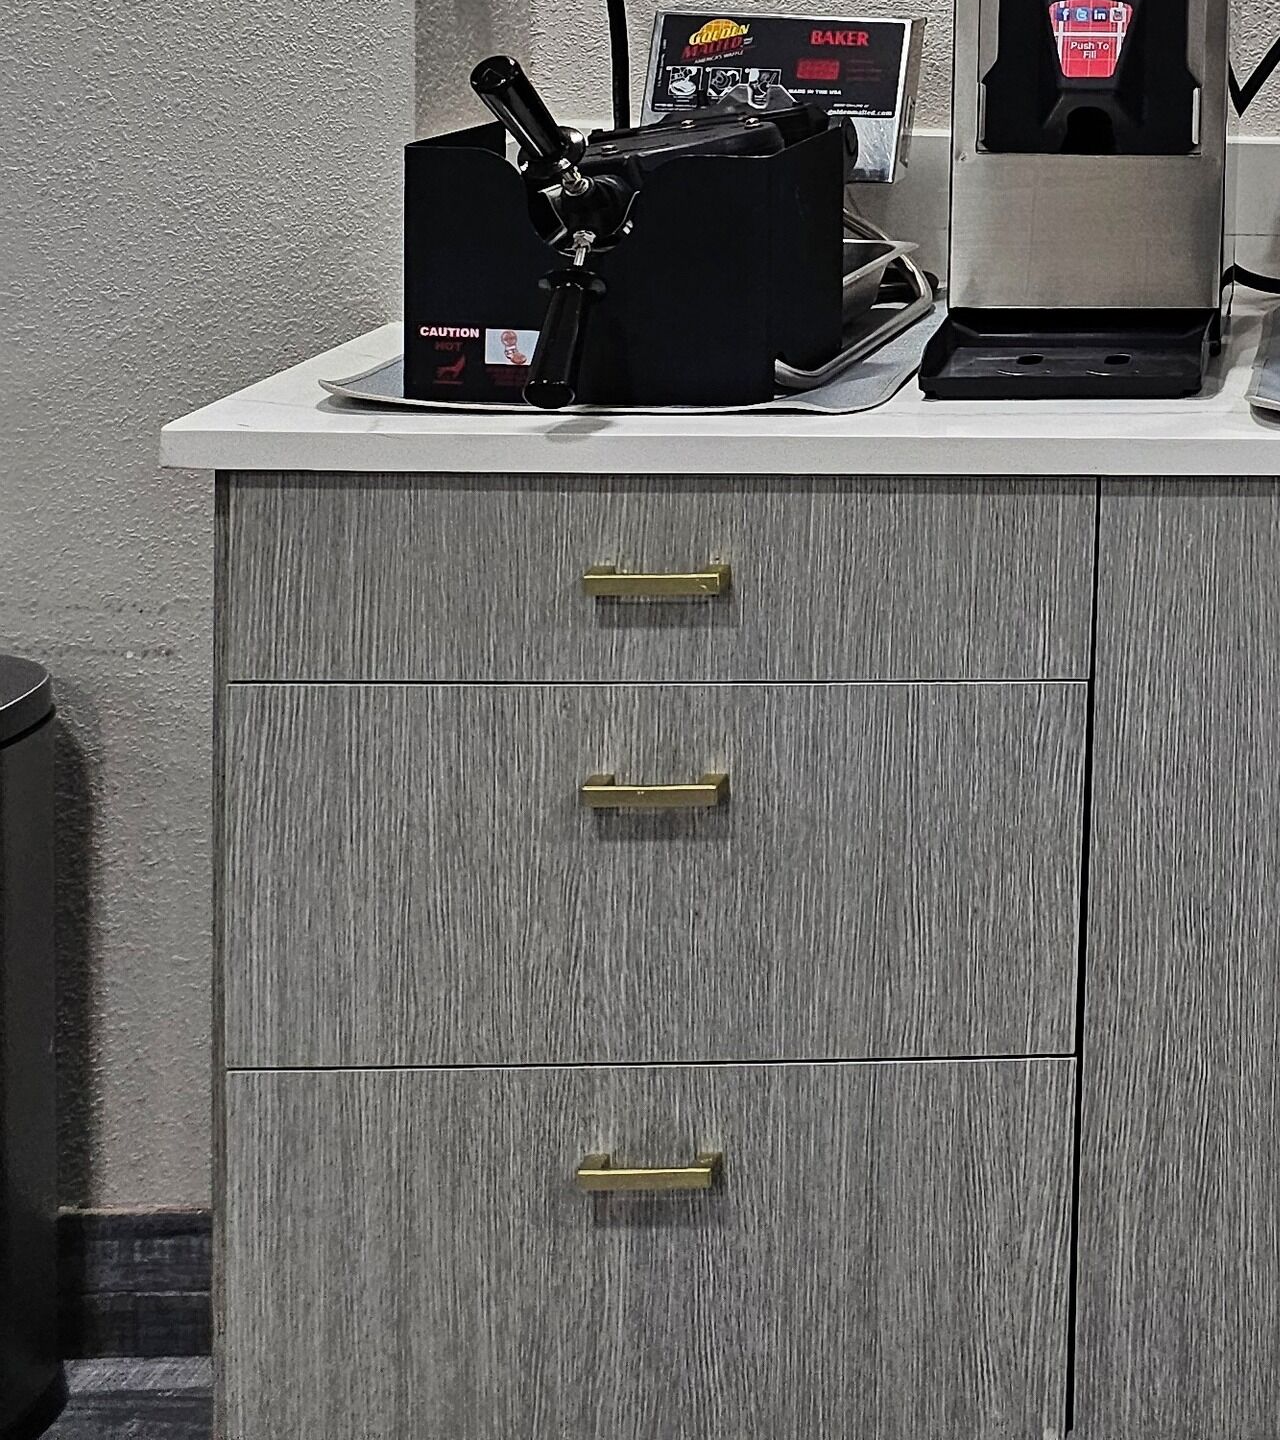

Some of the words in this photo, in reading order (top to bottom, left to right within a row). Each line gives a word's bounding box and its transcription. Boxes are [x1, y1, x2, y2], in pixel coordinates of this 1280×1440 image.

[689, 24, 750, 46] GOLDEN
[811, 30, 869, 46] BAKER
[1071, 41, 1094, 50] Push
[1097, 41, 1109, 50] To
[1083, 50, 1096, 59] Fill
[420, 326, 480, 338] CAUTION
[435, 342, 463, 352] HOT
